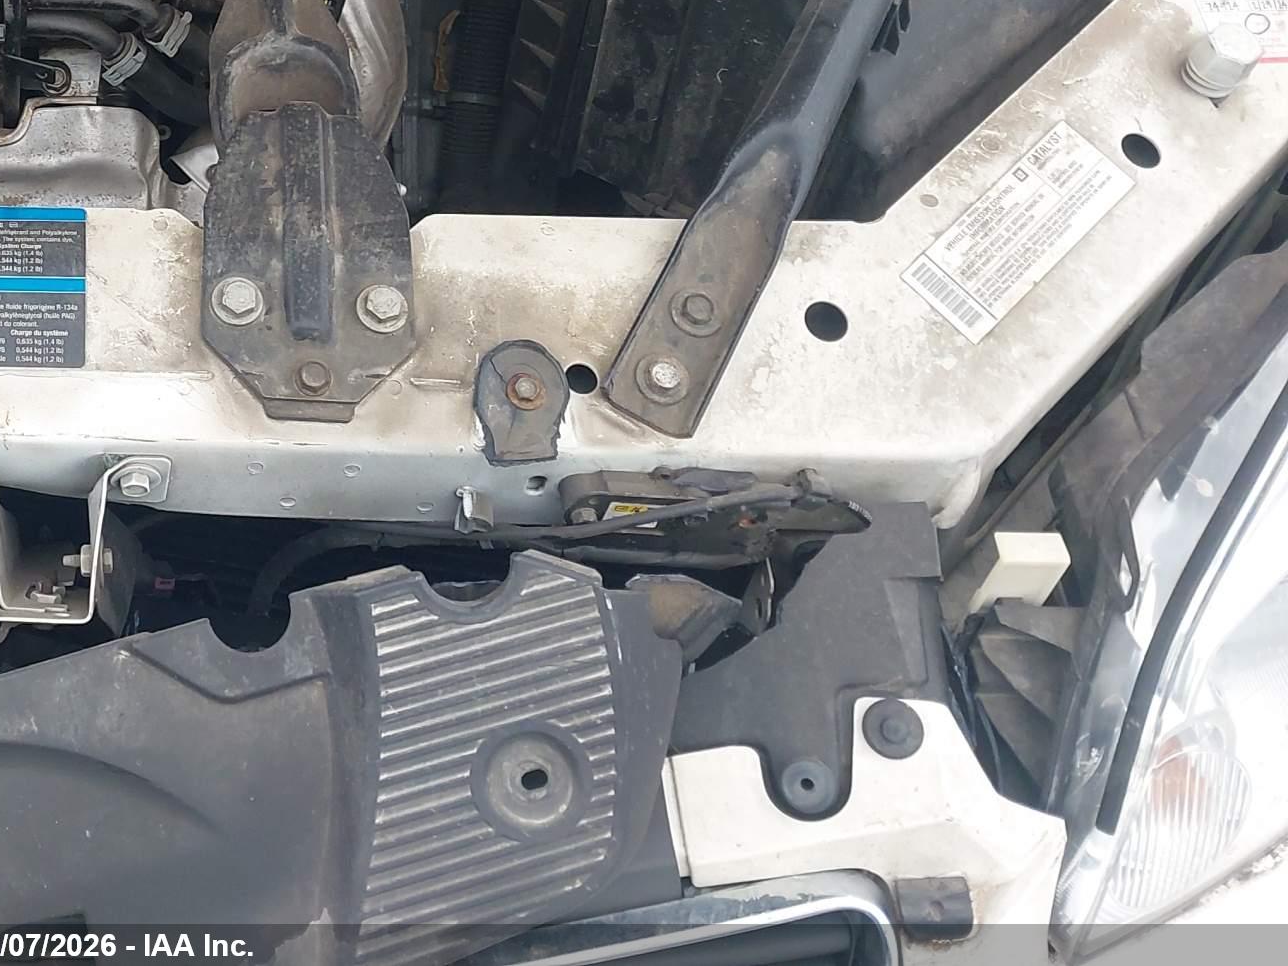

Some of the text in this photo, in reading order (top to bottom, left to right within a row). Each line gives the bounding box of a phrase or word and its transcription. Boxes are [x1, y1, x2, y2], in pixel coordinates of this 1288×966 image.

[1027, 131, 1063, 165] CATALYST
[10, 329, 33, 337] Charge
[34, 338, 42, 346] kg
[33, 346, 64, 355] kg lb)
[33, 355, 42, 364] kg
[55, 356, 64, 364] lb)
